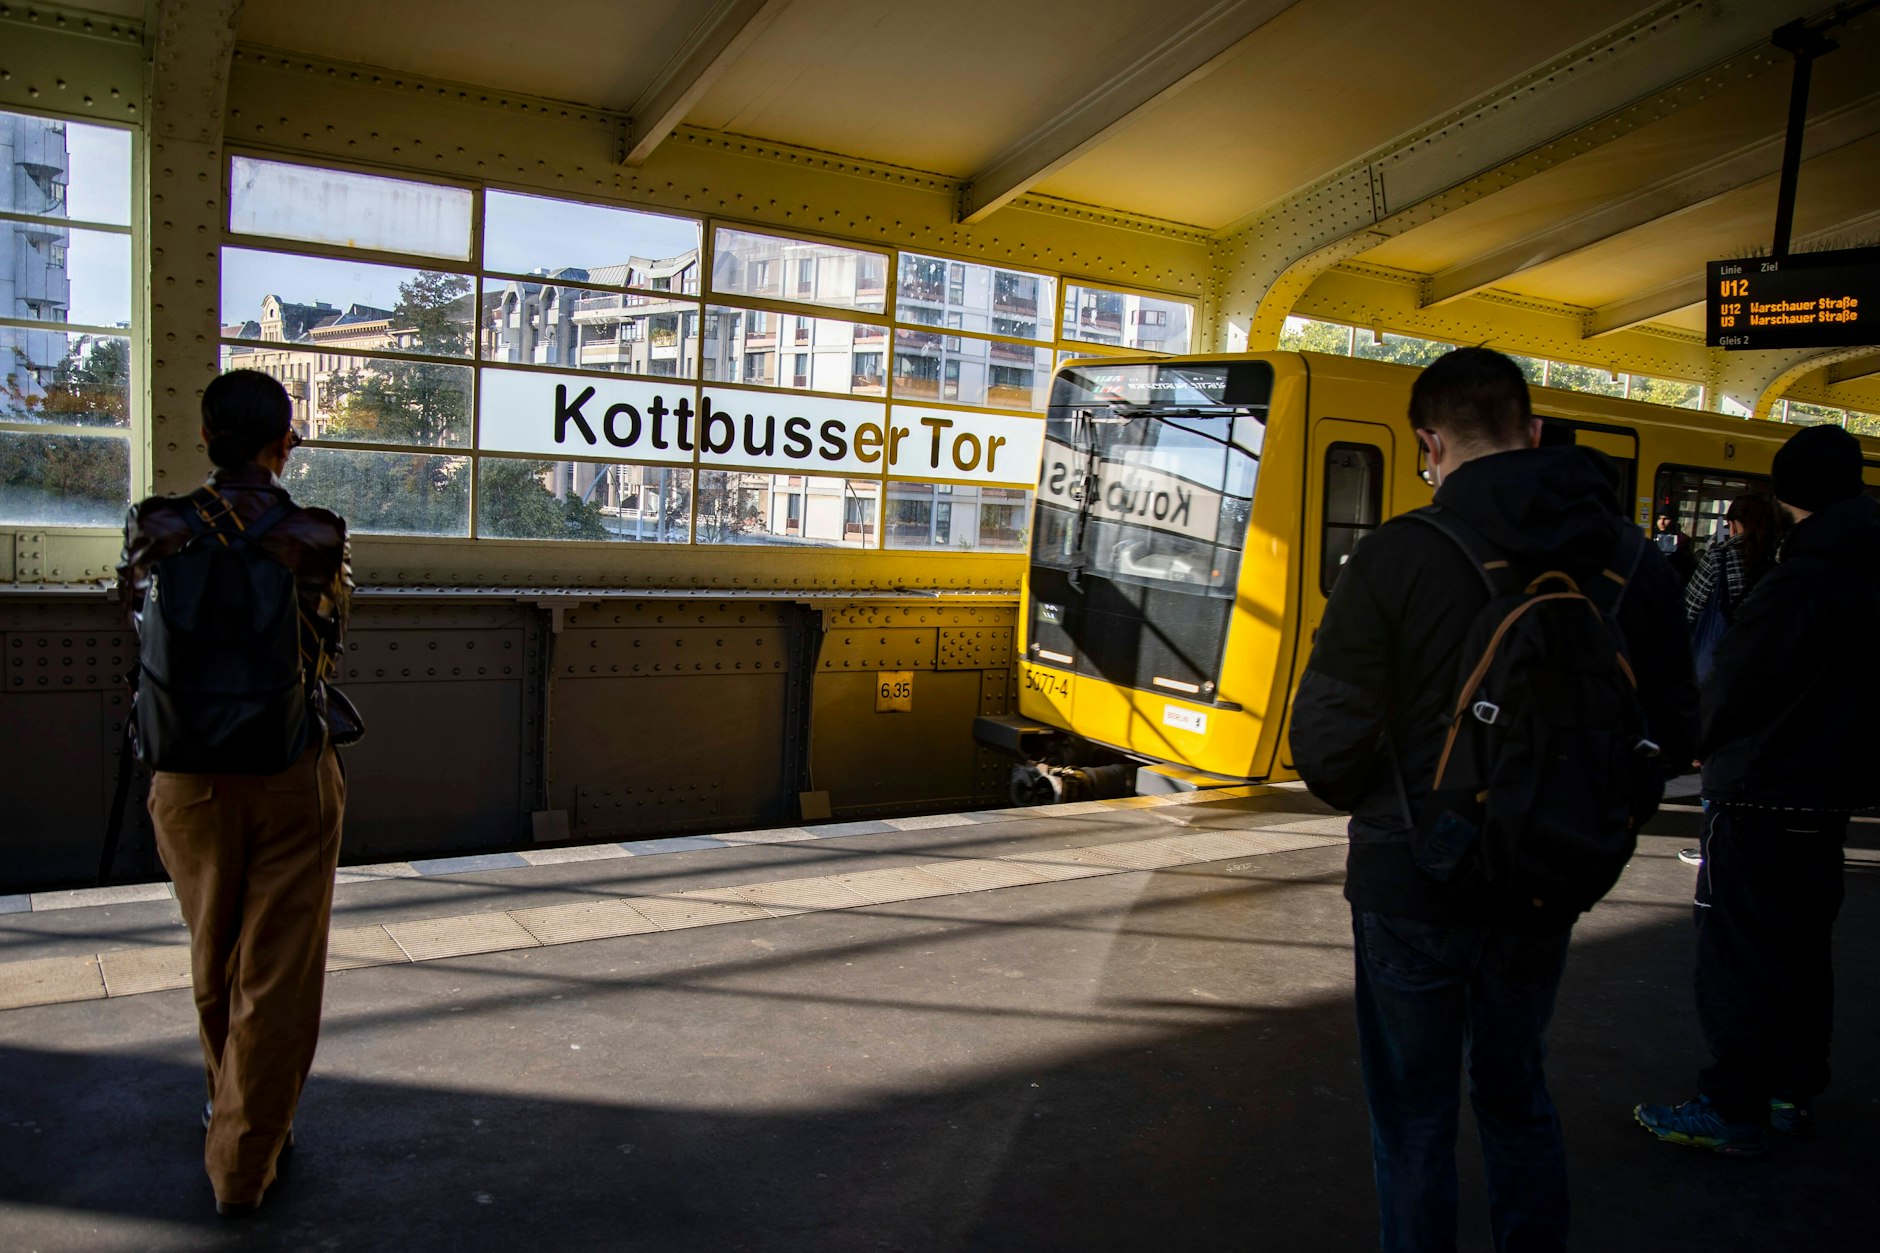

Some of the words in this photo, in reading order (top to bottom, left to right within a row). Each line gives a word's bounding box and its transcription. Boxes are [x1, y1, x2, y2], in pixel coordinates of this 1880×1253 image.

[1720, 265, 1743, 276] Linie
[1760, 261, 1779, 273] Ziel
[1720, 279, 1749, 298] U12
[1720, 303, 1742, 316] U12
[1750, 299, 1816, 314] Warschauer
[1818, 296, 1859, 310] Straße
[1720, 316, 1735, 328] U3
[1750, 313, 1816, 326] Warschauer
[1818, 309, 1858, 323] Straße
[1719, 336, 1742, 346] Gleis
[1743, 335, 1749, 345] 2
[553, 383, 910, 466] Kottbusser
[919, 416, 1007, 474] Tor
